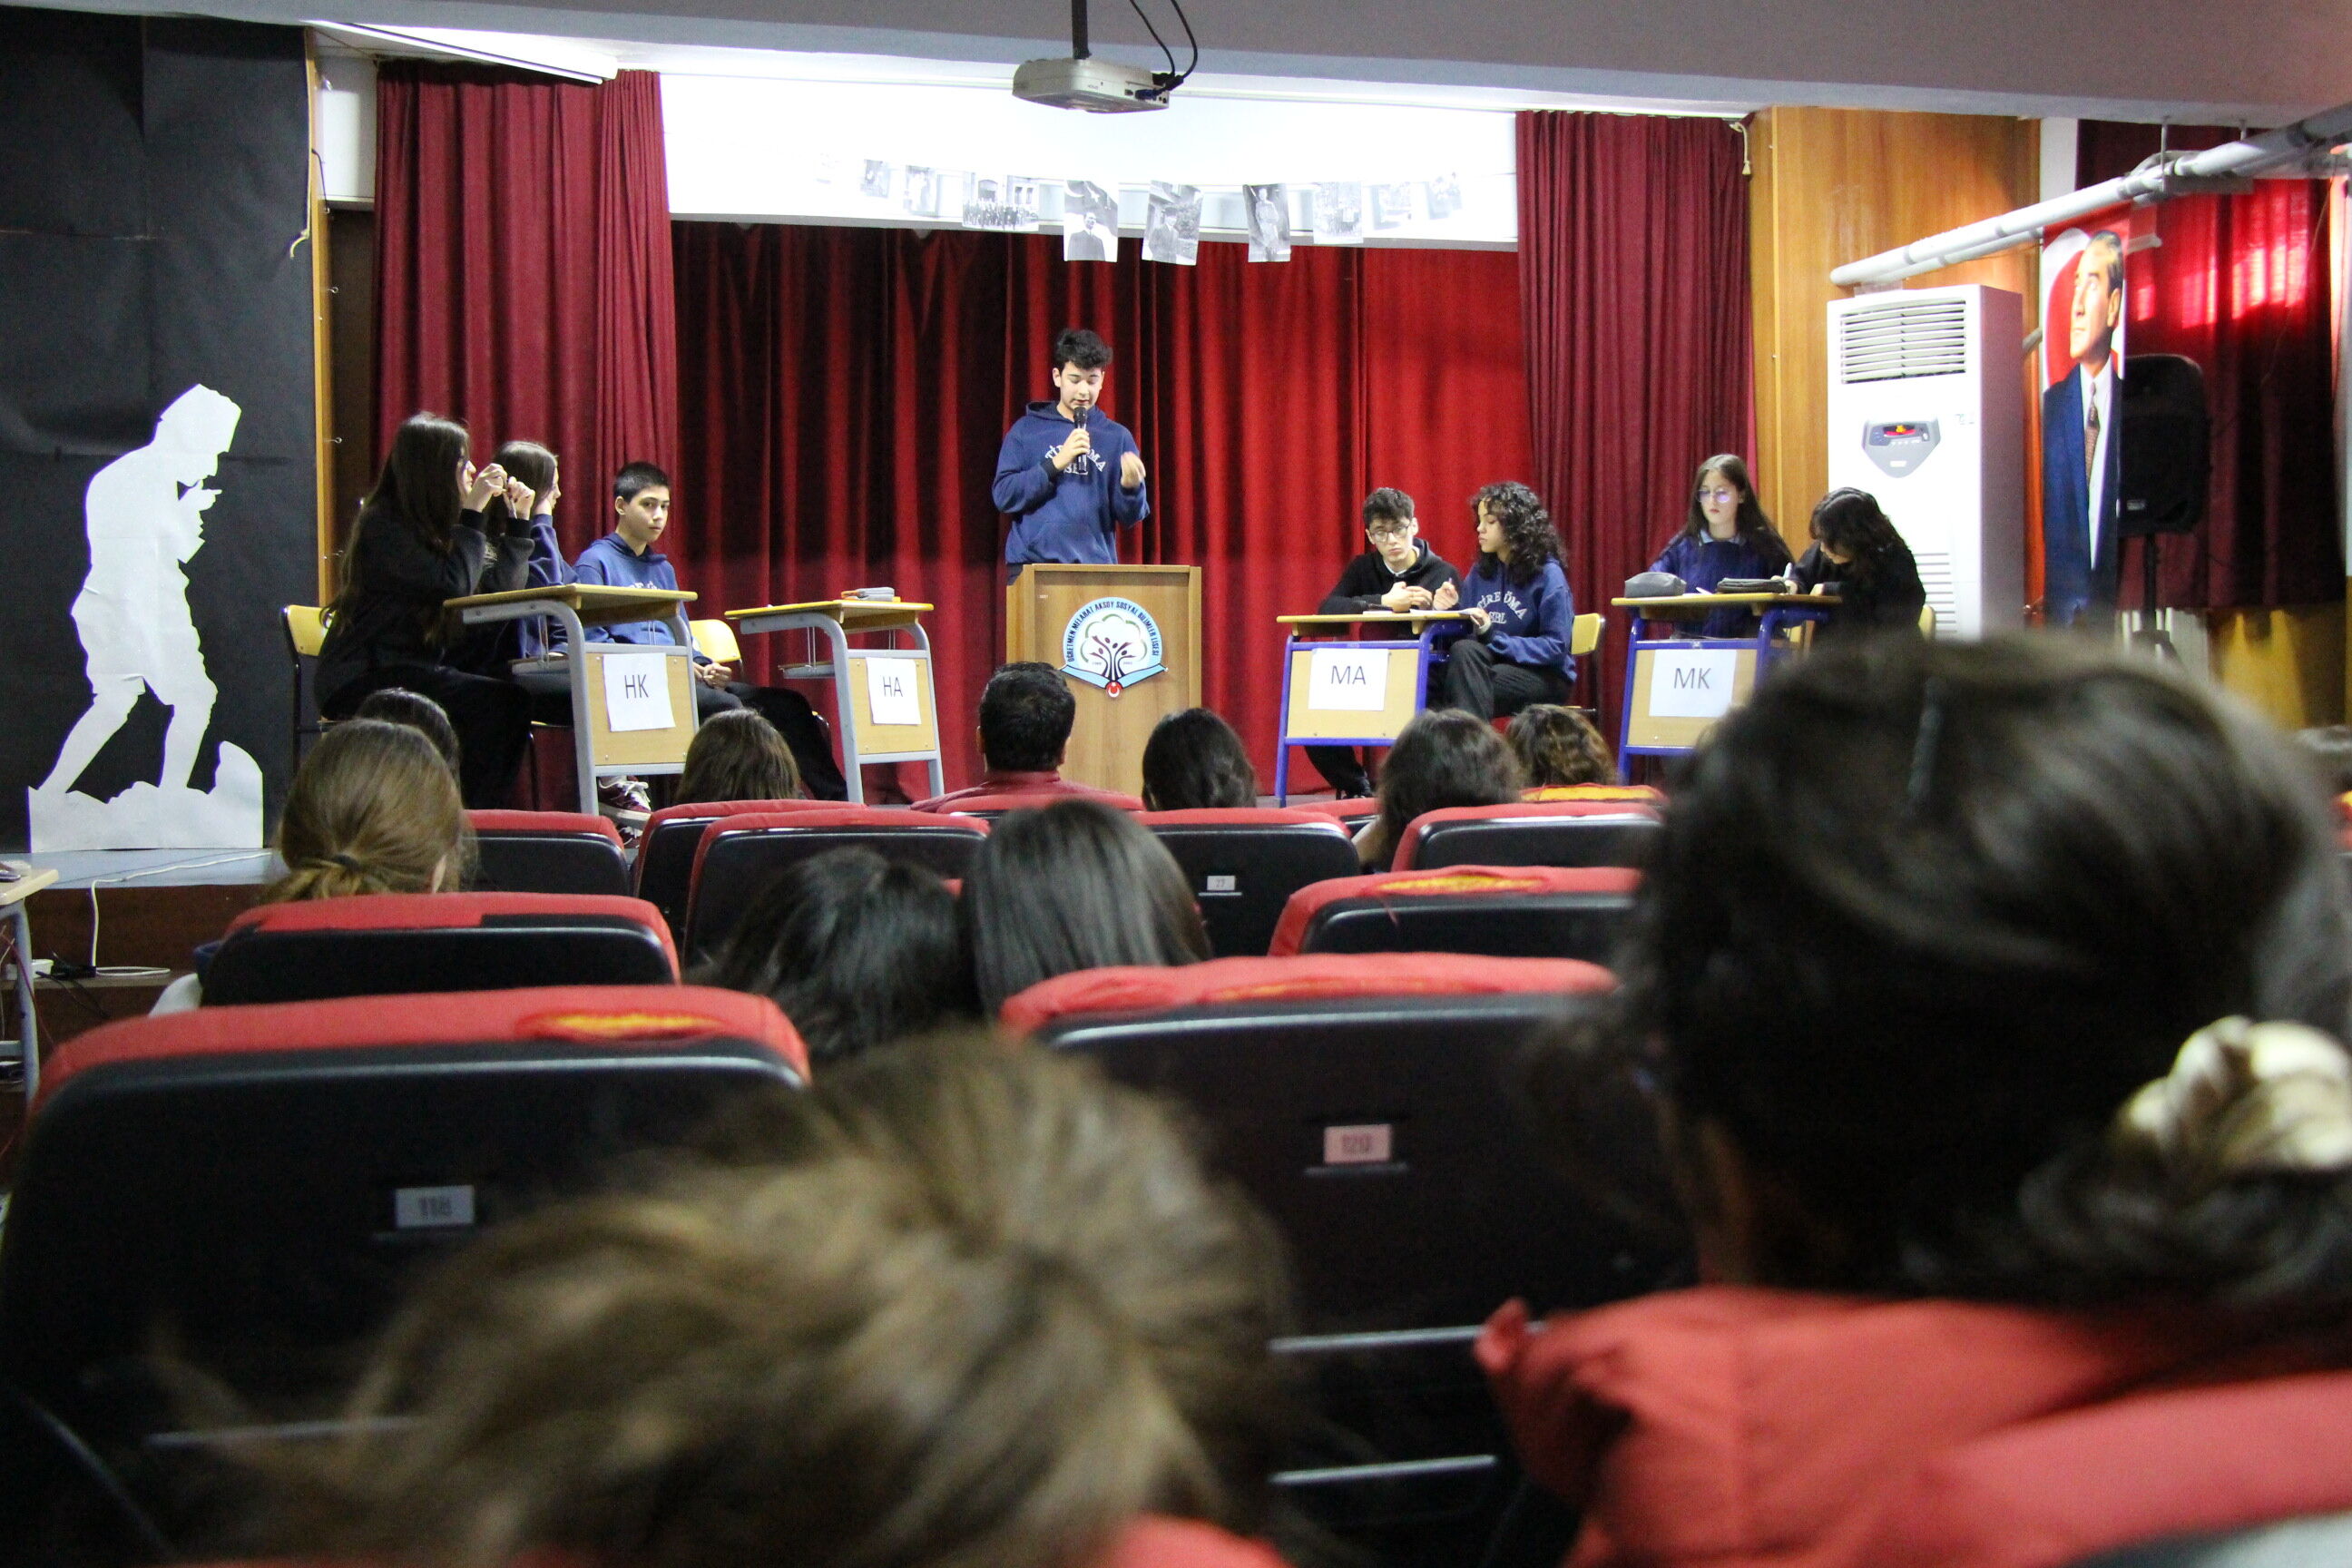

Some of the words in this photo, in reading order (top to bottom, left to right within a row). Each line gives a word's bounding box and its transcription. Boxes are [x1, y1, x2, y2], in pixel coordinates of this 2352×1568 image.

[624, 673, 649, 699] HK
[1330, 665, 1367, 685] MA
[1673, 667, 1711, 690] MK
[882, 676, 904, 698] HA
